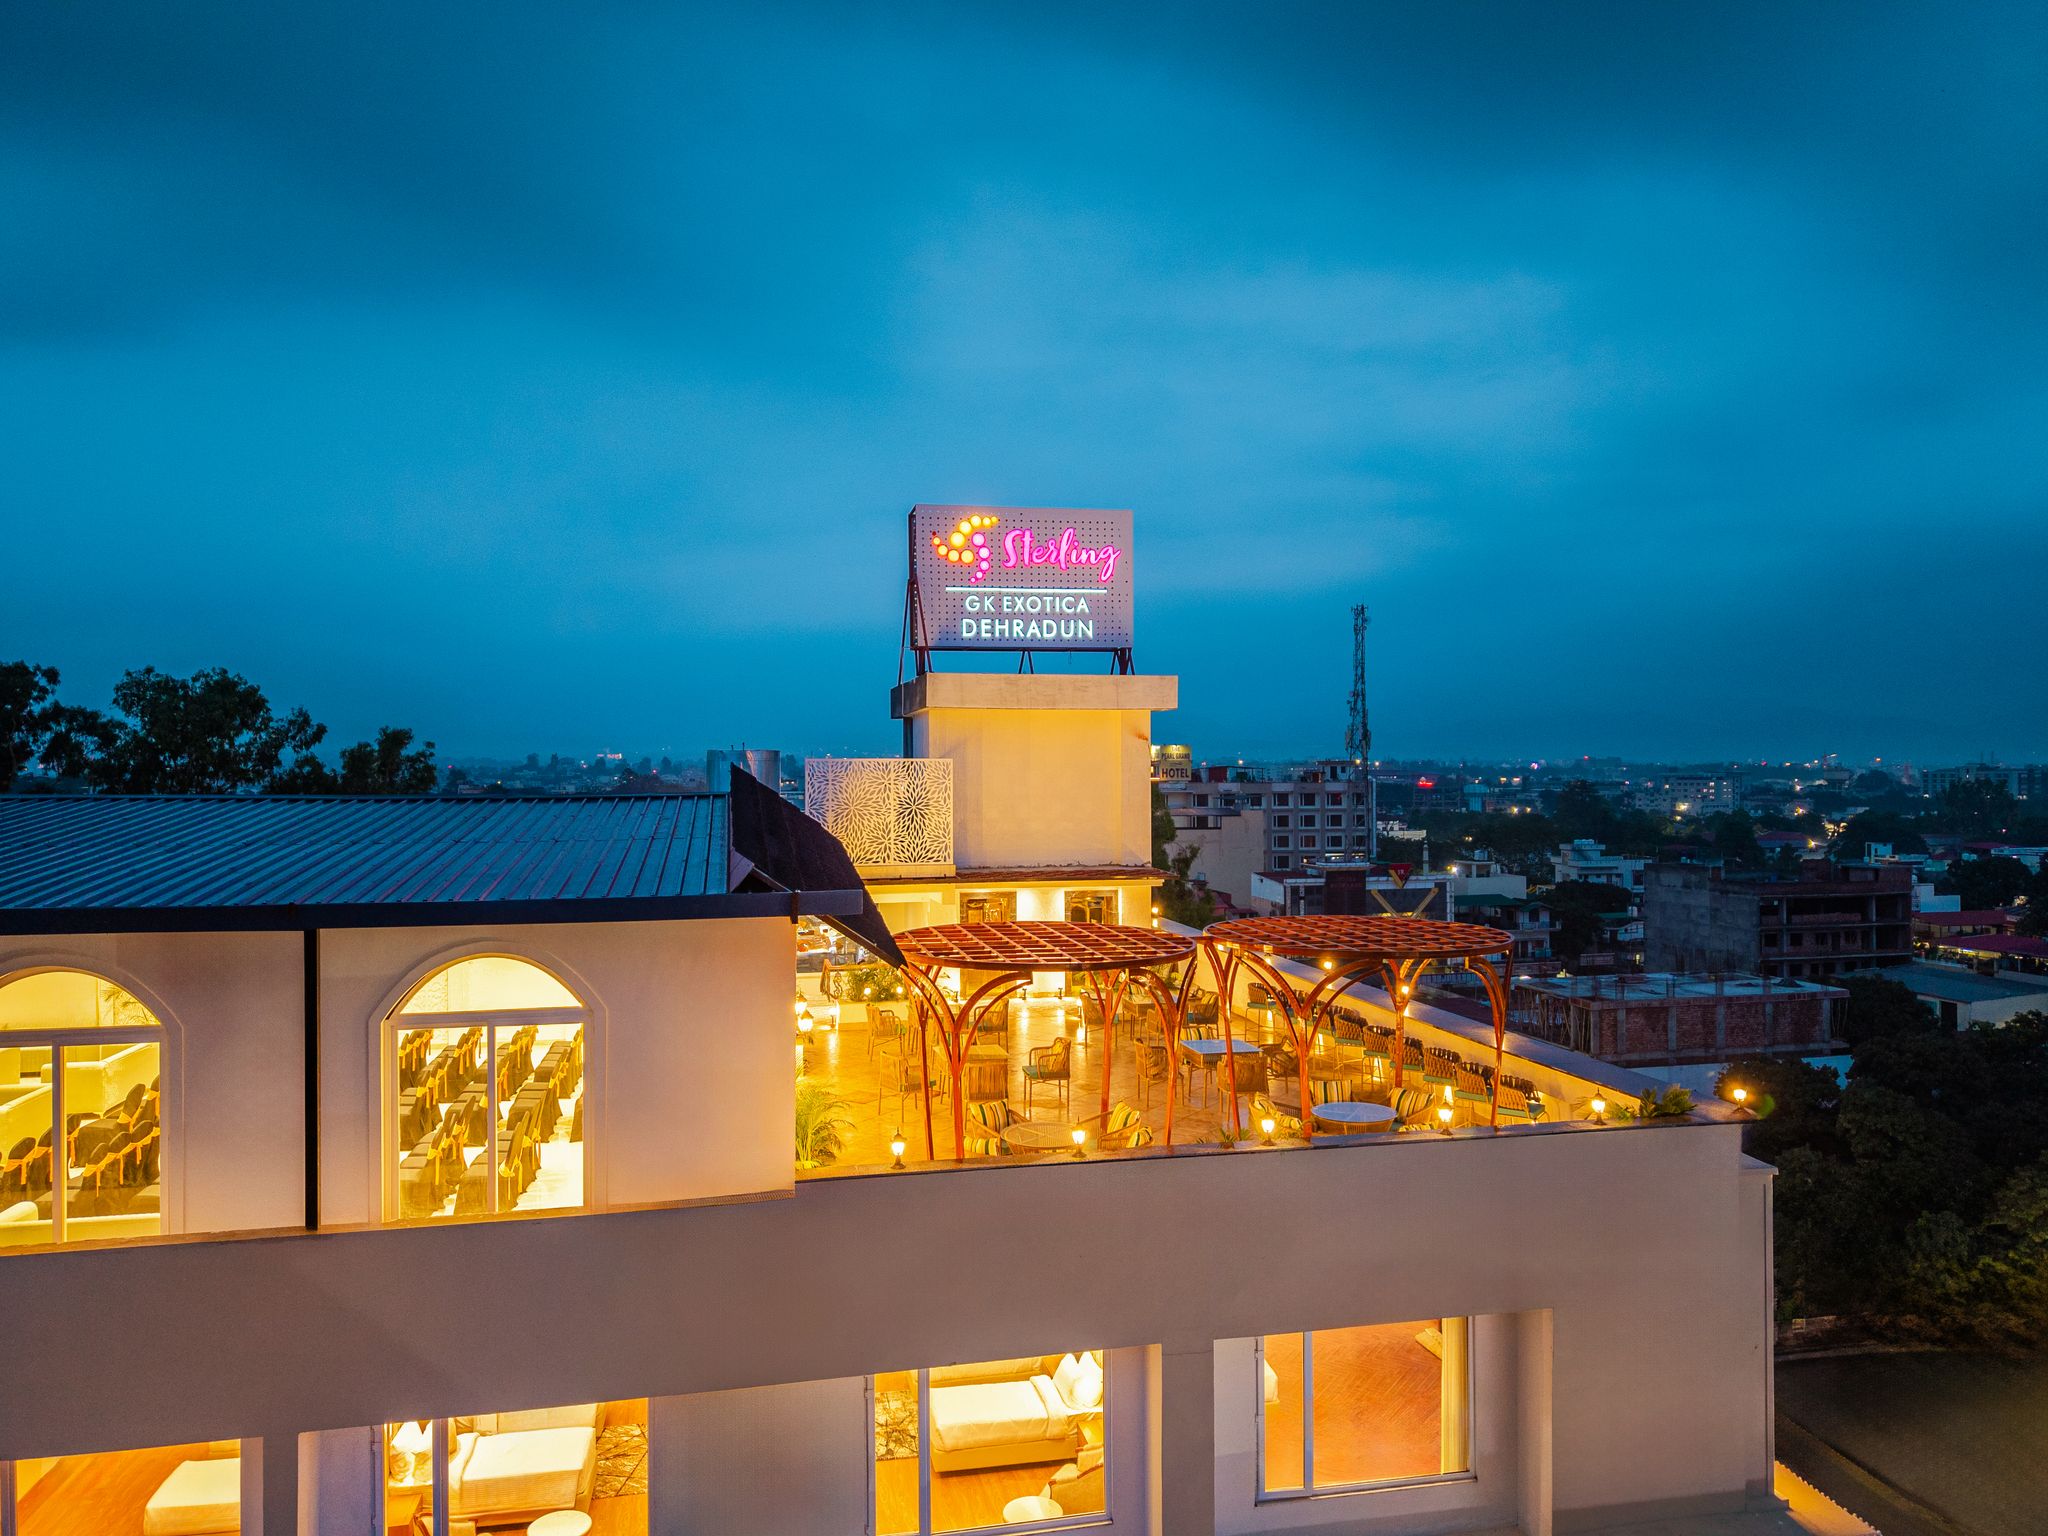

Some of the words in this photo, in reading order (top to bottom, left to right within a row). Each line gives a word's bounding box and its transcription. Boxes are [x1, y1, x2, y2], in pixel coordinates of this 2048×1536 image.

[1003, 527, 1121, 582] Sterling
[965, 595, 996, 613] GK
[1003, 596, 1090, 614] EXOTICA
[961, 618, 1093, 639] DEHRADUN
[1161, 767, 1189, 778] HOTEL
